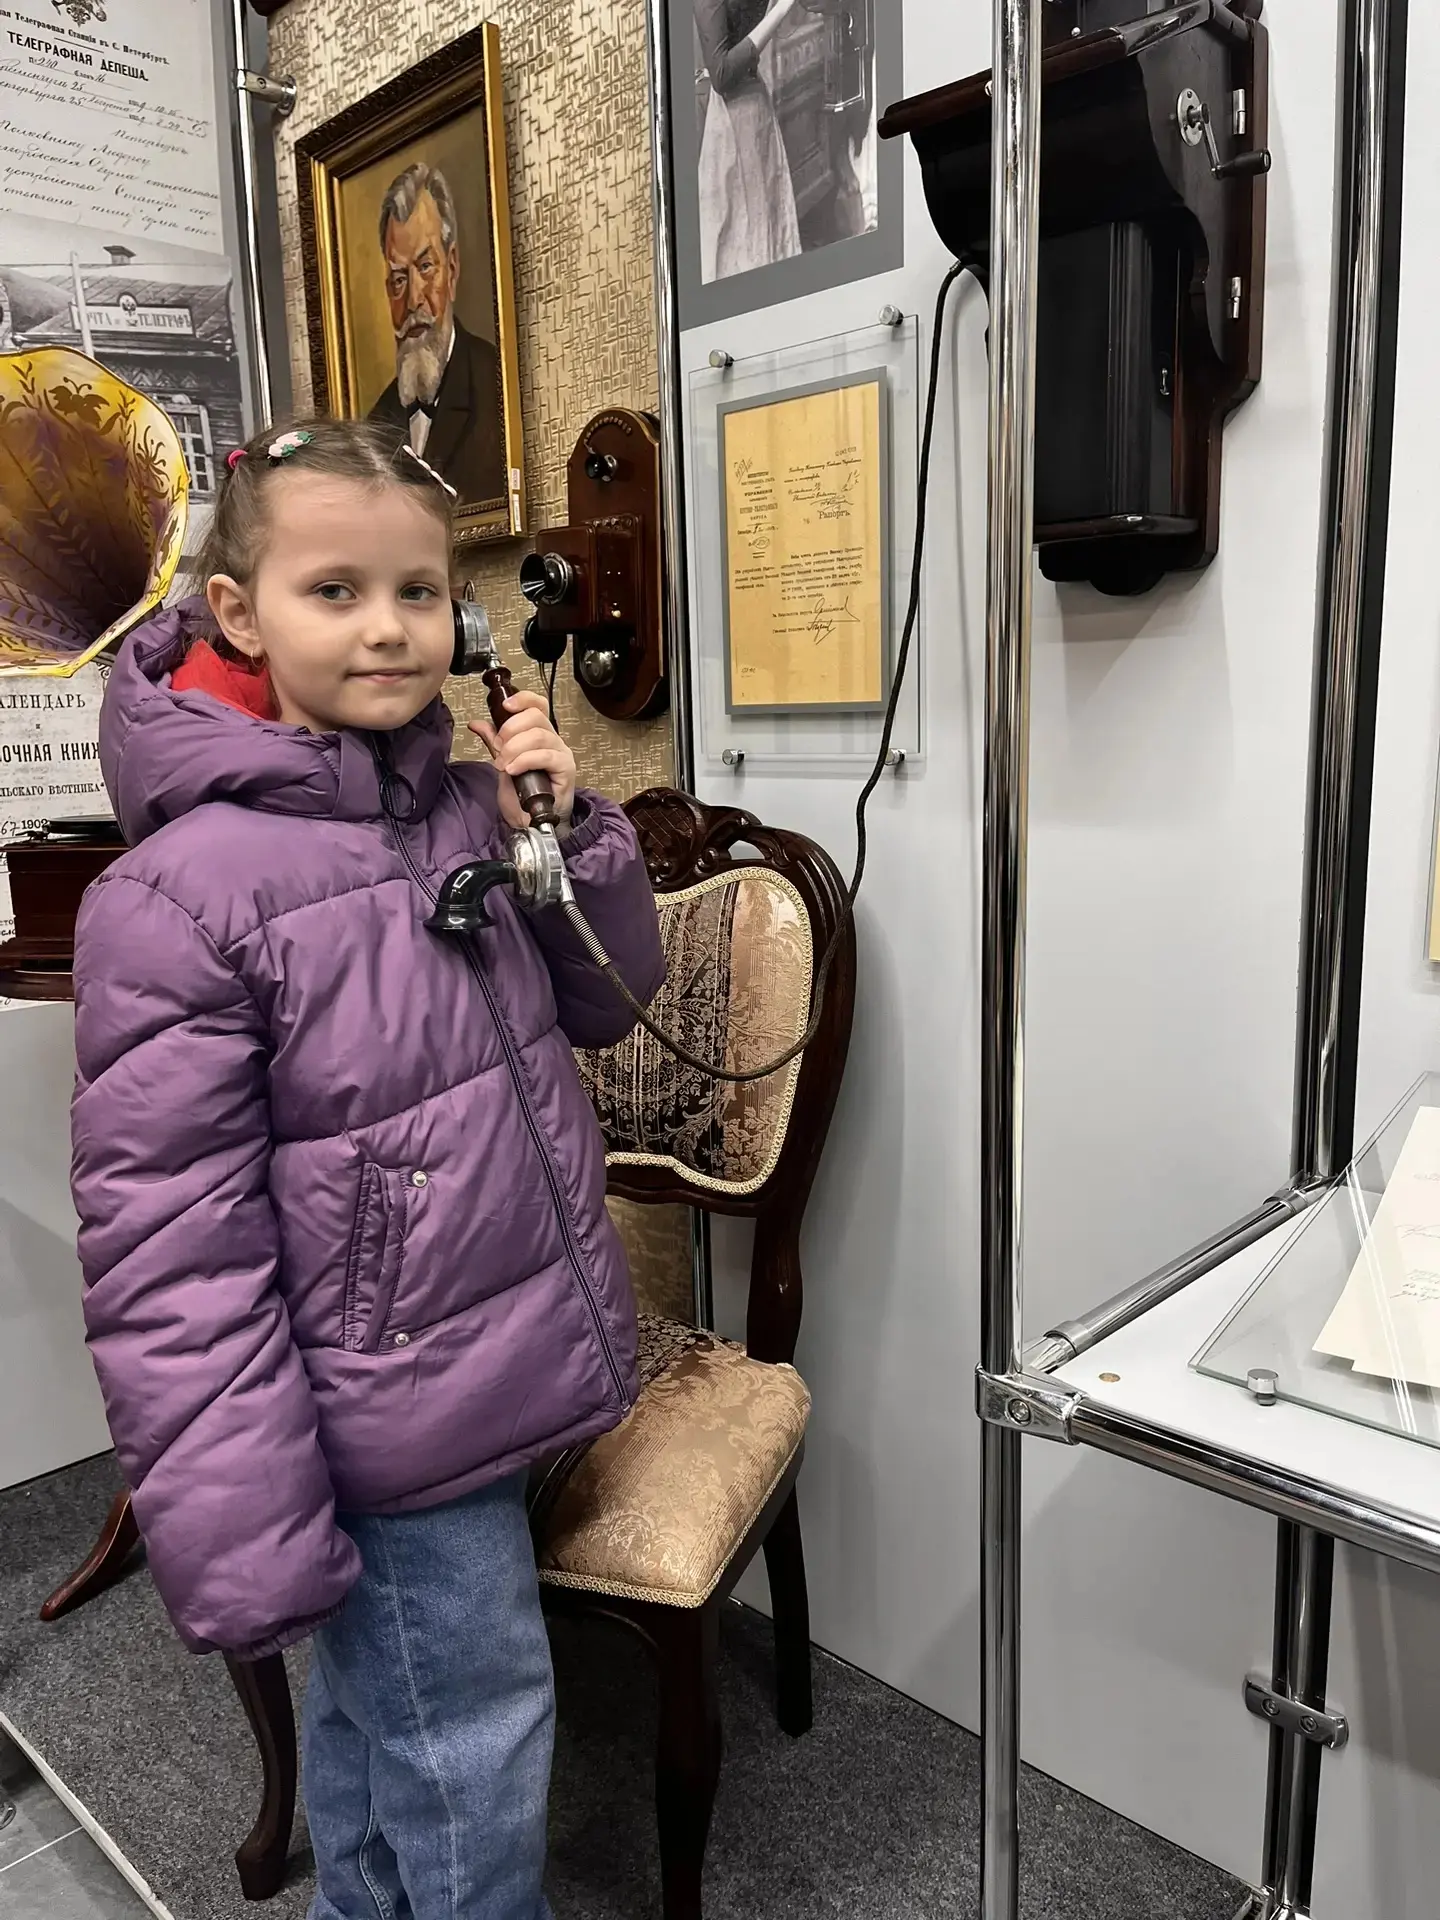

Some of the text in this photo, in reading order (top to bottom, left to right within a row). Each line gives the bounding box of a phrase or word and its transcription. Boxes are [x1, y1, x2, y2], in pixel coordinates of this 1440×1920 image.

[7, 30, 149, 82] ТЕЛЕГРАФНАЯ ДЕПЕША.
[0, 743, 52, 763] ОЧНАЯ
